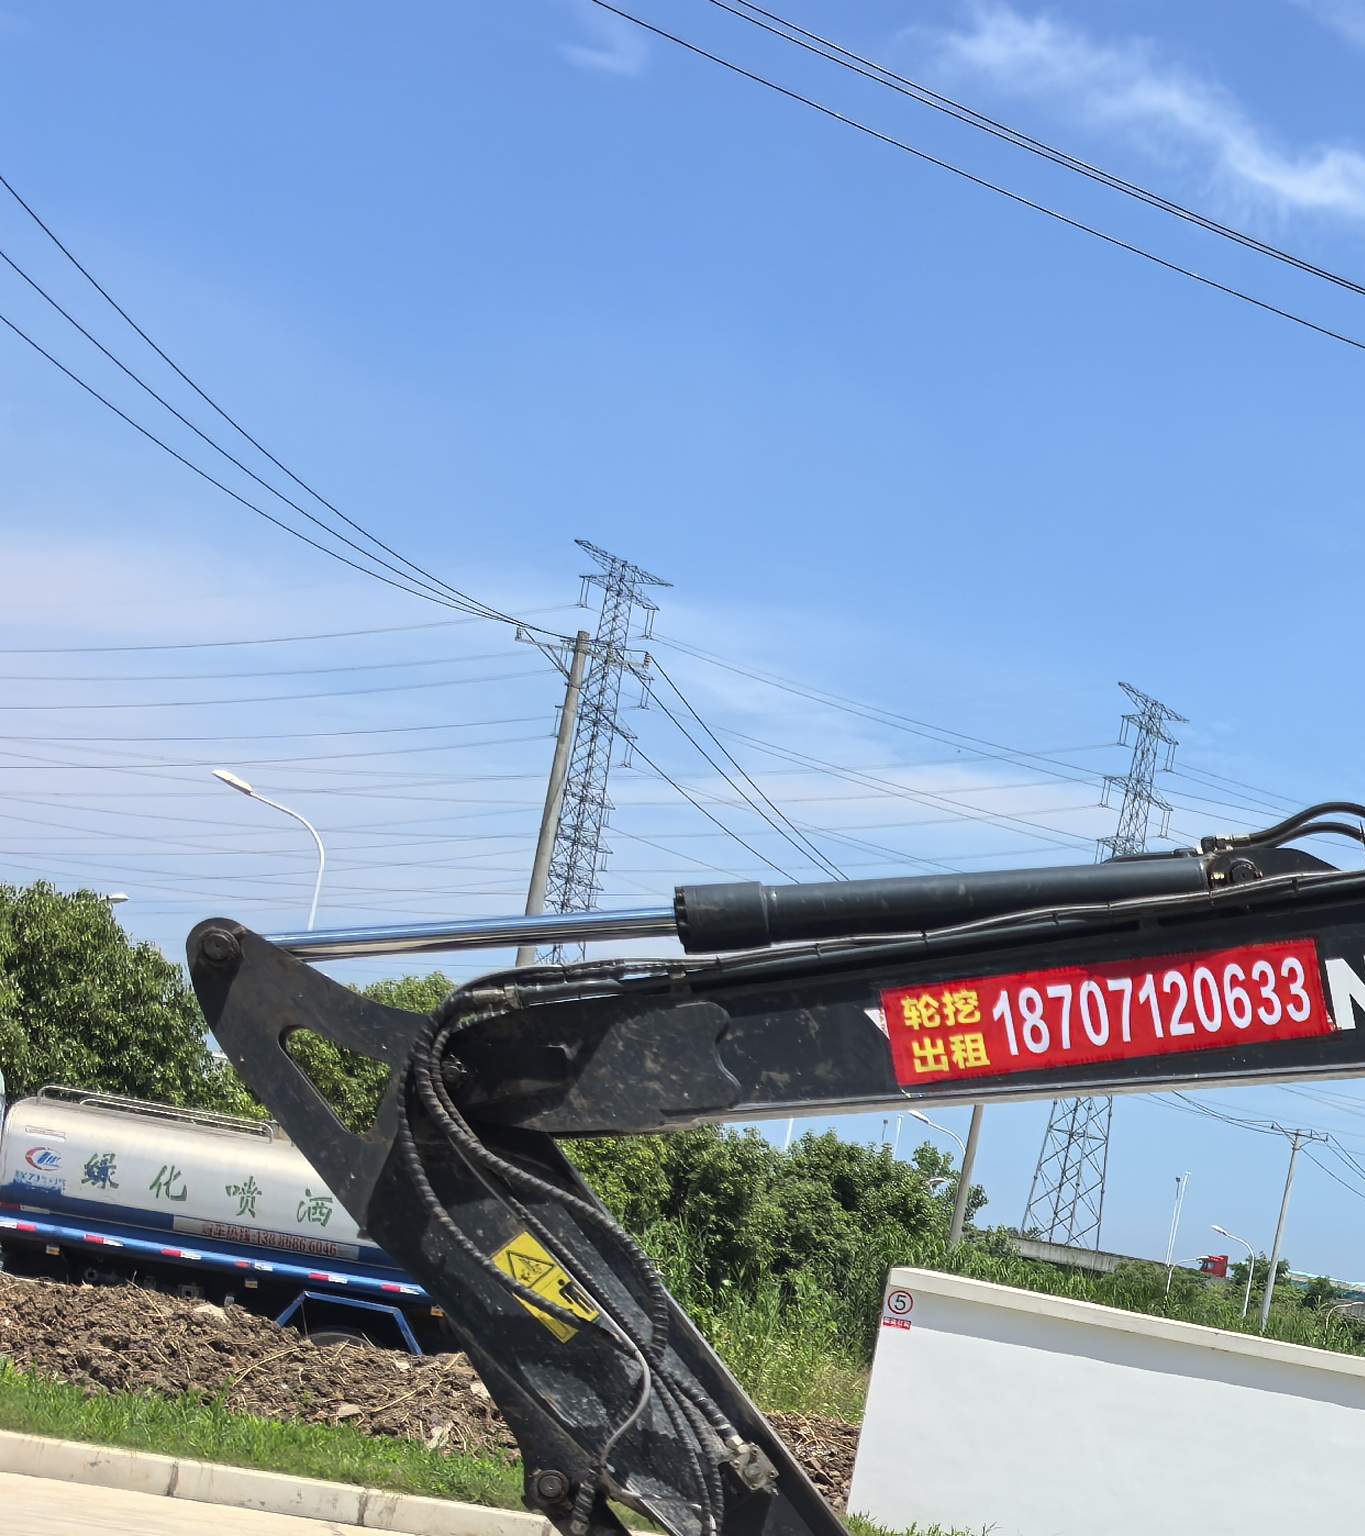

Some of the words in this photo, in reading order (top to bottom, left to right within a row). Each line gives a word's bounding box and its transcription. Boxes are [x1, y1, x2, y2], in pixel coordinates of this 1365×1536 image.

[902, 990, 981, 1030] 轮挖
[992, 957, 1311, 1057] 18707120633
[912, 1031, 991, 1073] 出租
[895, 1295, 906, 1310] 5
